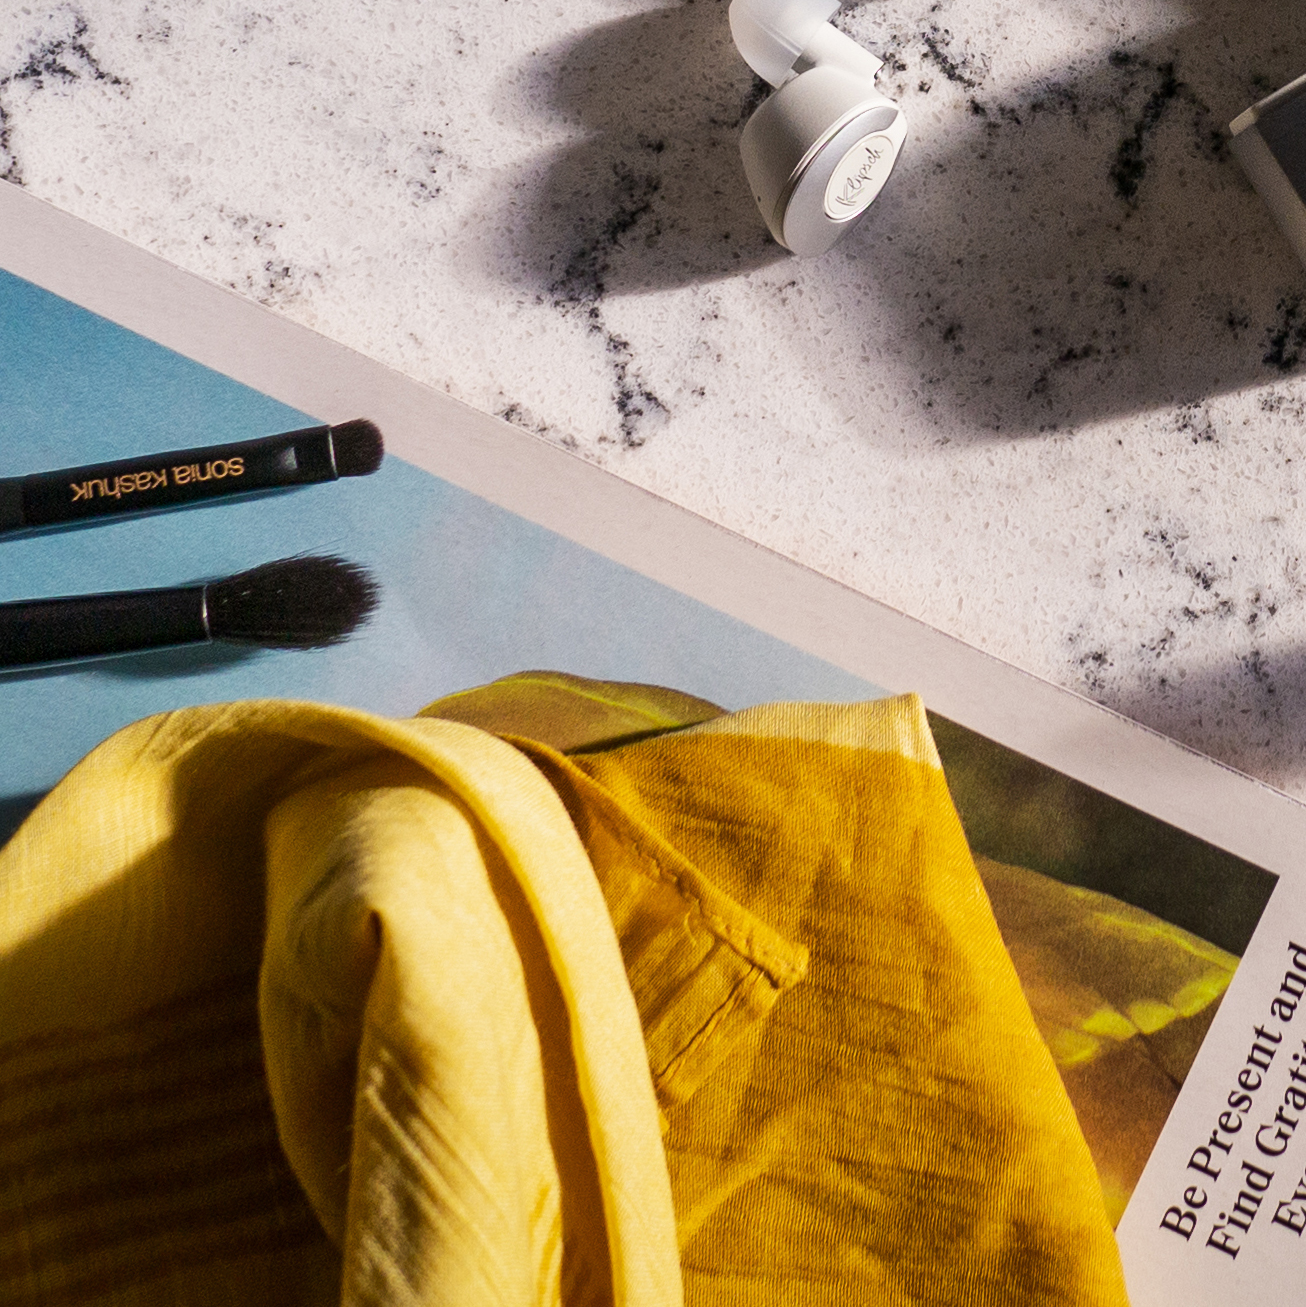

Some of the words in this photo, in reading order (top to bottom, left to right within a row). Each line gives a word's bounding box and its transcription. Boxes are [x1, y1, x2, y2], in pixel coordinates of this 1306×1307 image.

[834, 146, 885, 207] Klipsch
[68, 468, 168, 502] kashuk
[173, 456, 245, 485] sonia
[1158, 1184, 1208, 1243] Be
[1187, 1024, 1284, 1182] Present
[1206, 1160, 1275, 1261] Find
